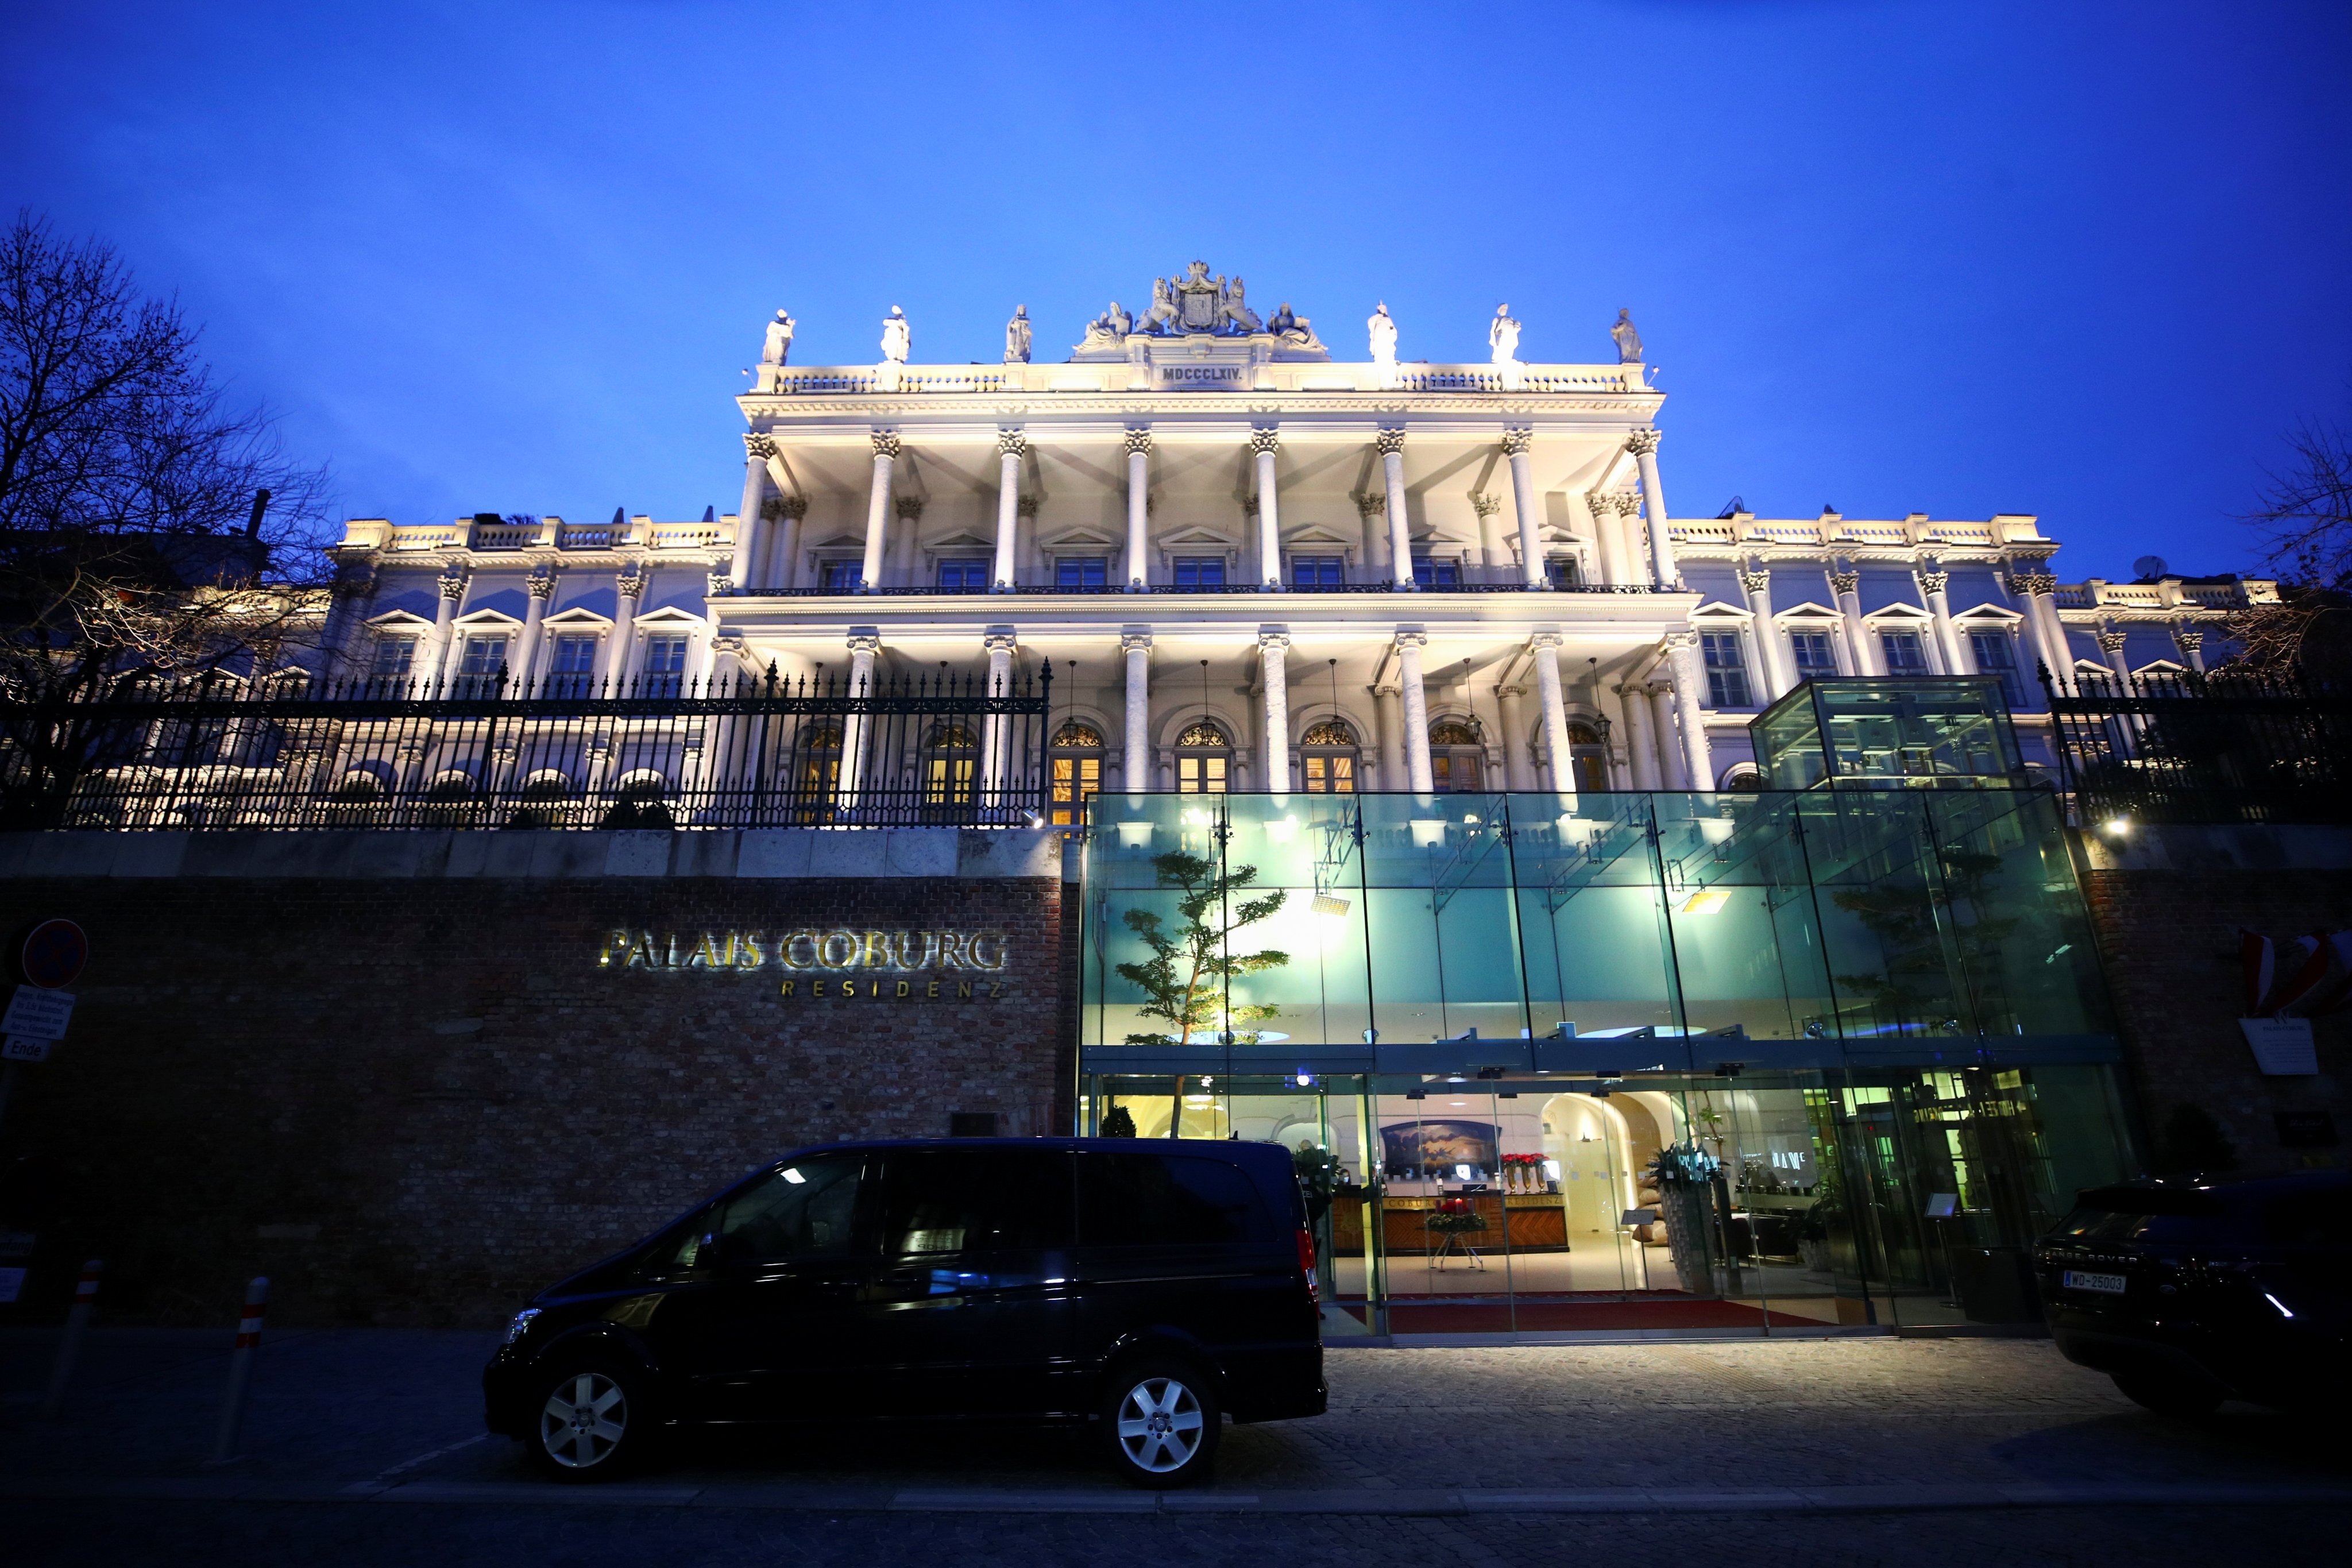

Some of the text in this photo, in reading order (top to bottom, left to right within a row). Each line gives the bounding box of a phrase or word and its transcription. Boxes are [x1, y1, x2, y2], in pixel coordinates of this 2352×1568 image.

[596, 928, 1005, 970] PALAIS COBURG
[782, 980, 1001, 998] RESIDENZ
[11, 1040, 41, 1057] Ende
[1508, 1196, 1560, 1206] RESIDENZ
[0, 1238, 32, 1254] nfang
[2088, 1254, 2138, 1264] ROVER
[2072, 1273, 2122, 1290] WD-25003
